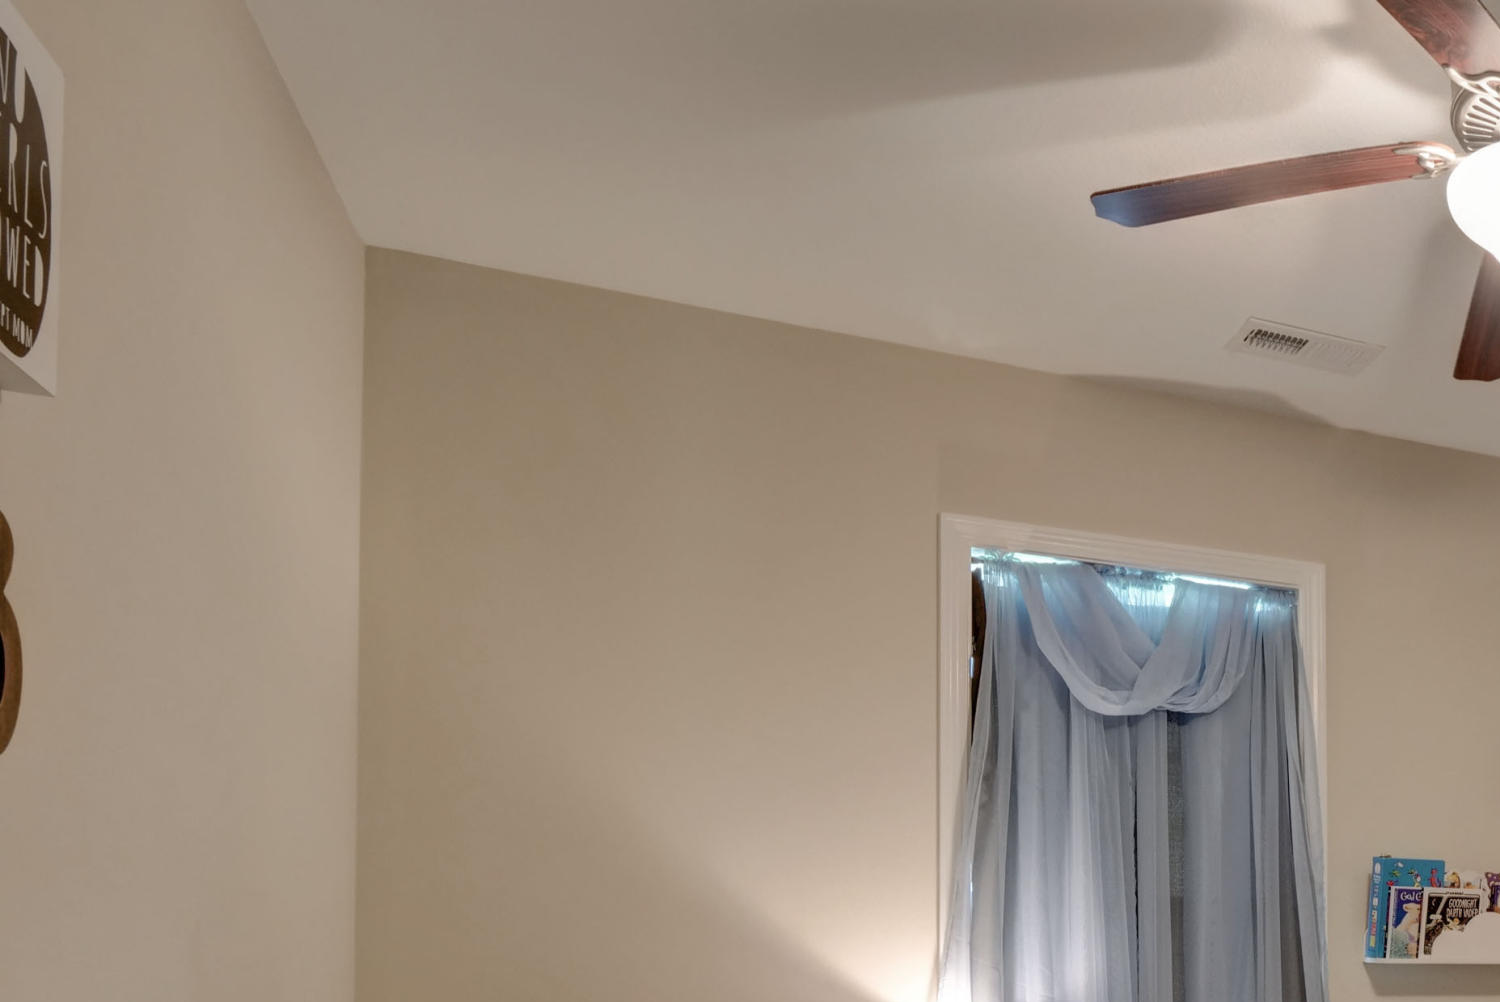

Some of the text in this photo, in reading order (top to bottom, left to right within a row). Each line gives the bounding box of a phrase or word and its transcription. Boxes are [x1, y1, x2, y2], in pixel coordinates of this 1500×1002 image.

[6, 122, 48, 239] RLS
[5, 215, 44, 308] WED
[1448, 898, 1477, 908] GOODNIGHT
